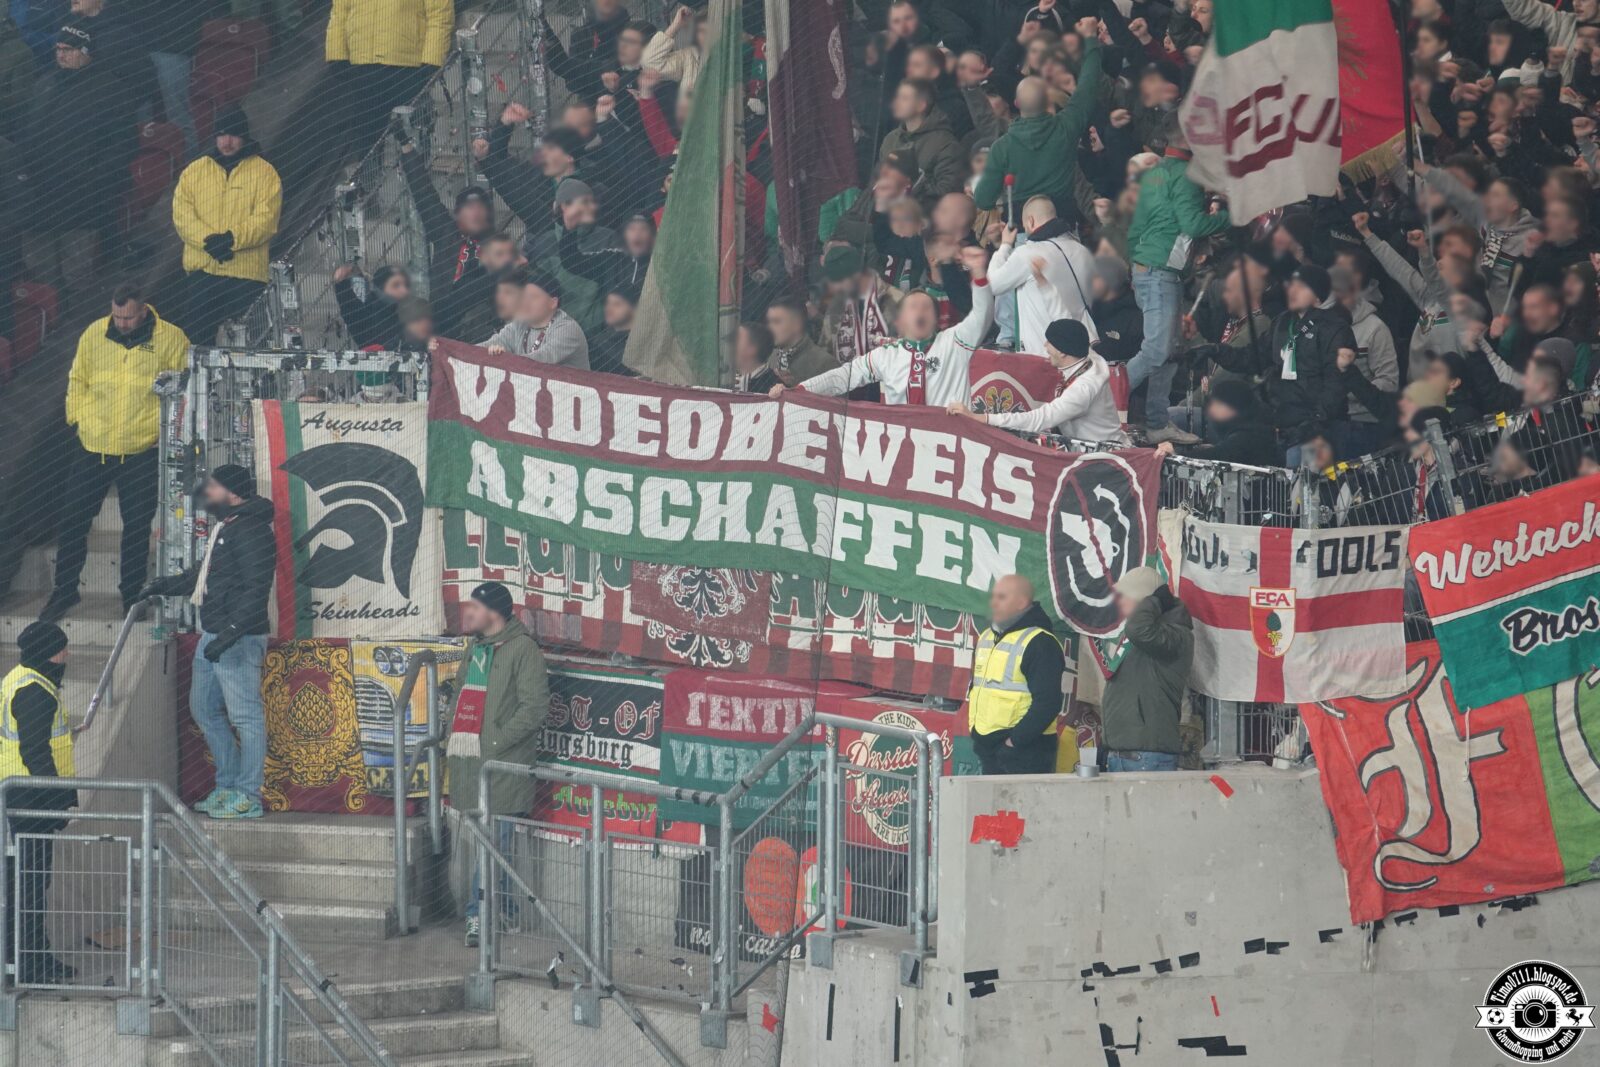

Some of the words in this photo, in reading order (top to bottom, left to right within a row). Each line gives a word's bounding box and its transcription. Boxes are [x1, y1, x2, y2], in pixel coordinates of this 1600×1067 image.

[301, 411, 405, 437] Augusta
[448, 357, 1036, 520] VIDEOBEWEIS
[467, 440, 1021, 591] ABSCHAFFEN
[300, 600, 421, 621] Skinheads
[1255, 592, 1291, 607] FCA
[1501, 597, 1600, 655] Bros
[896, 712, 917, 729] KIDS
